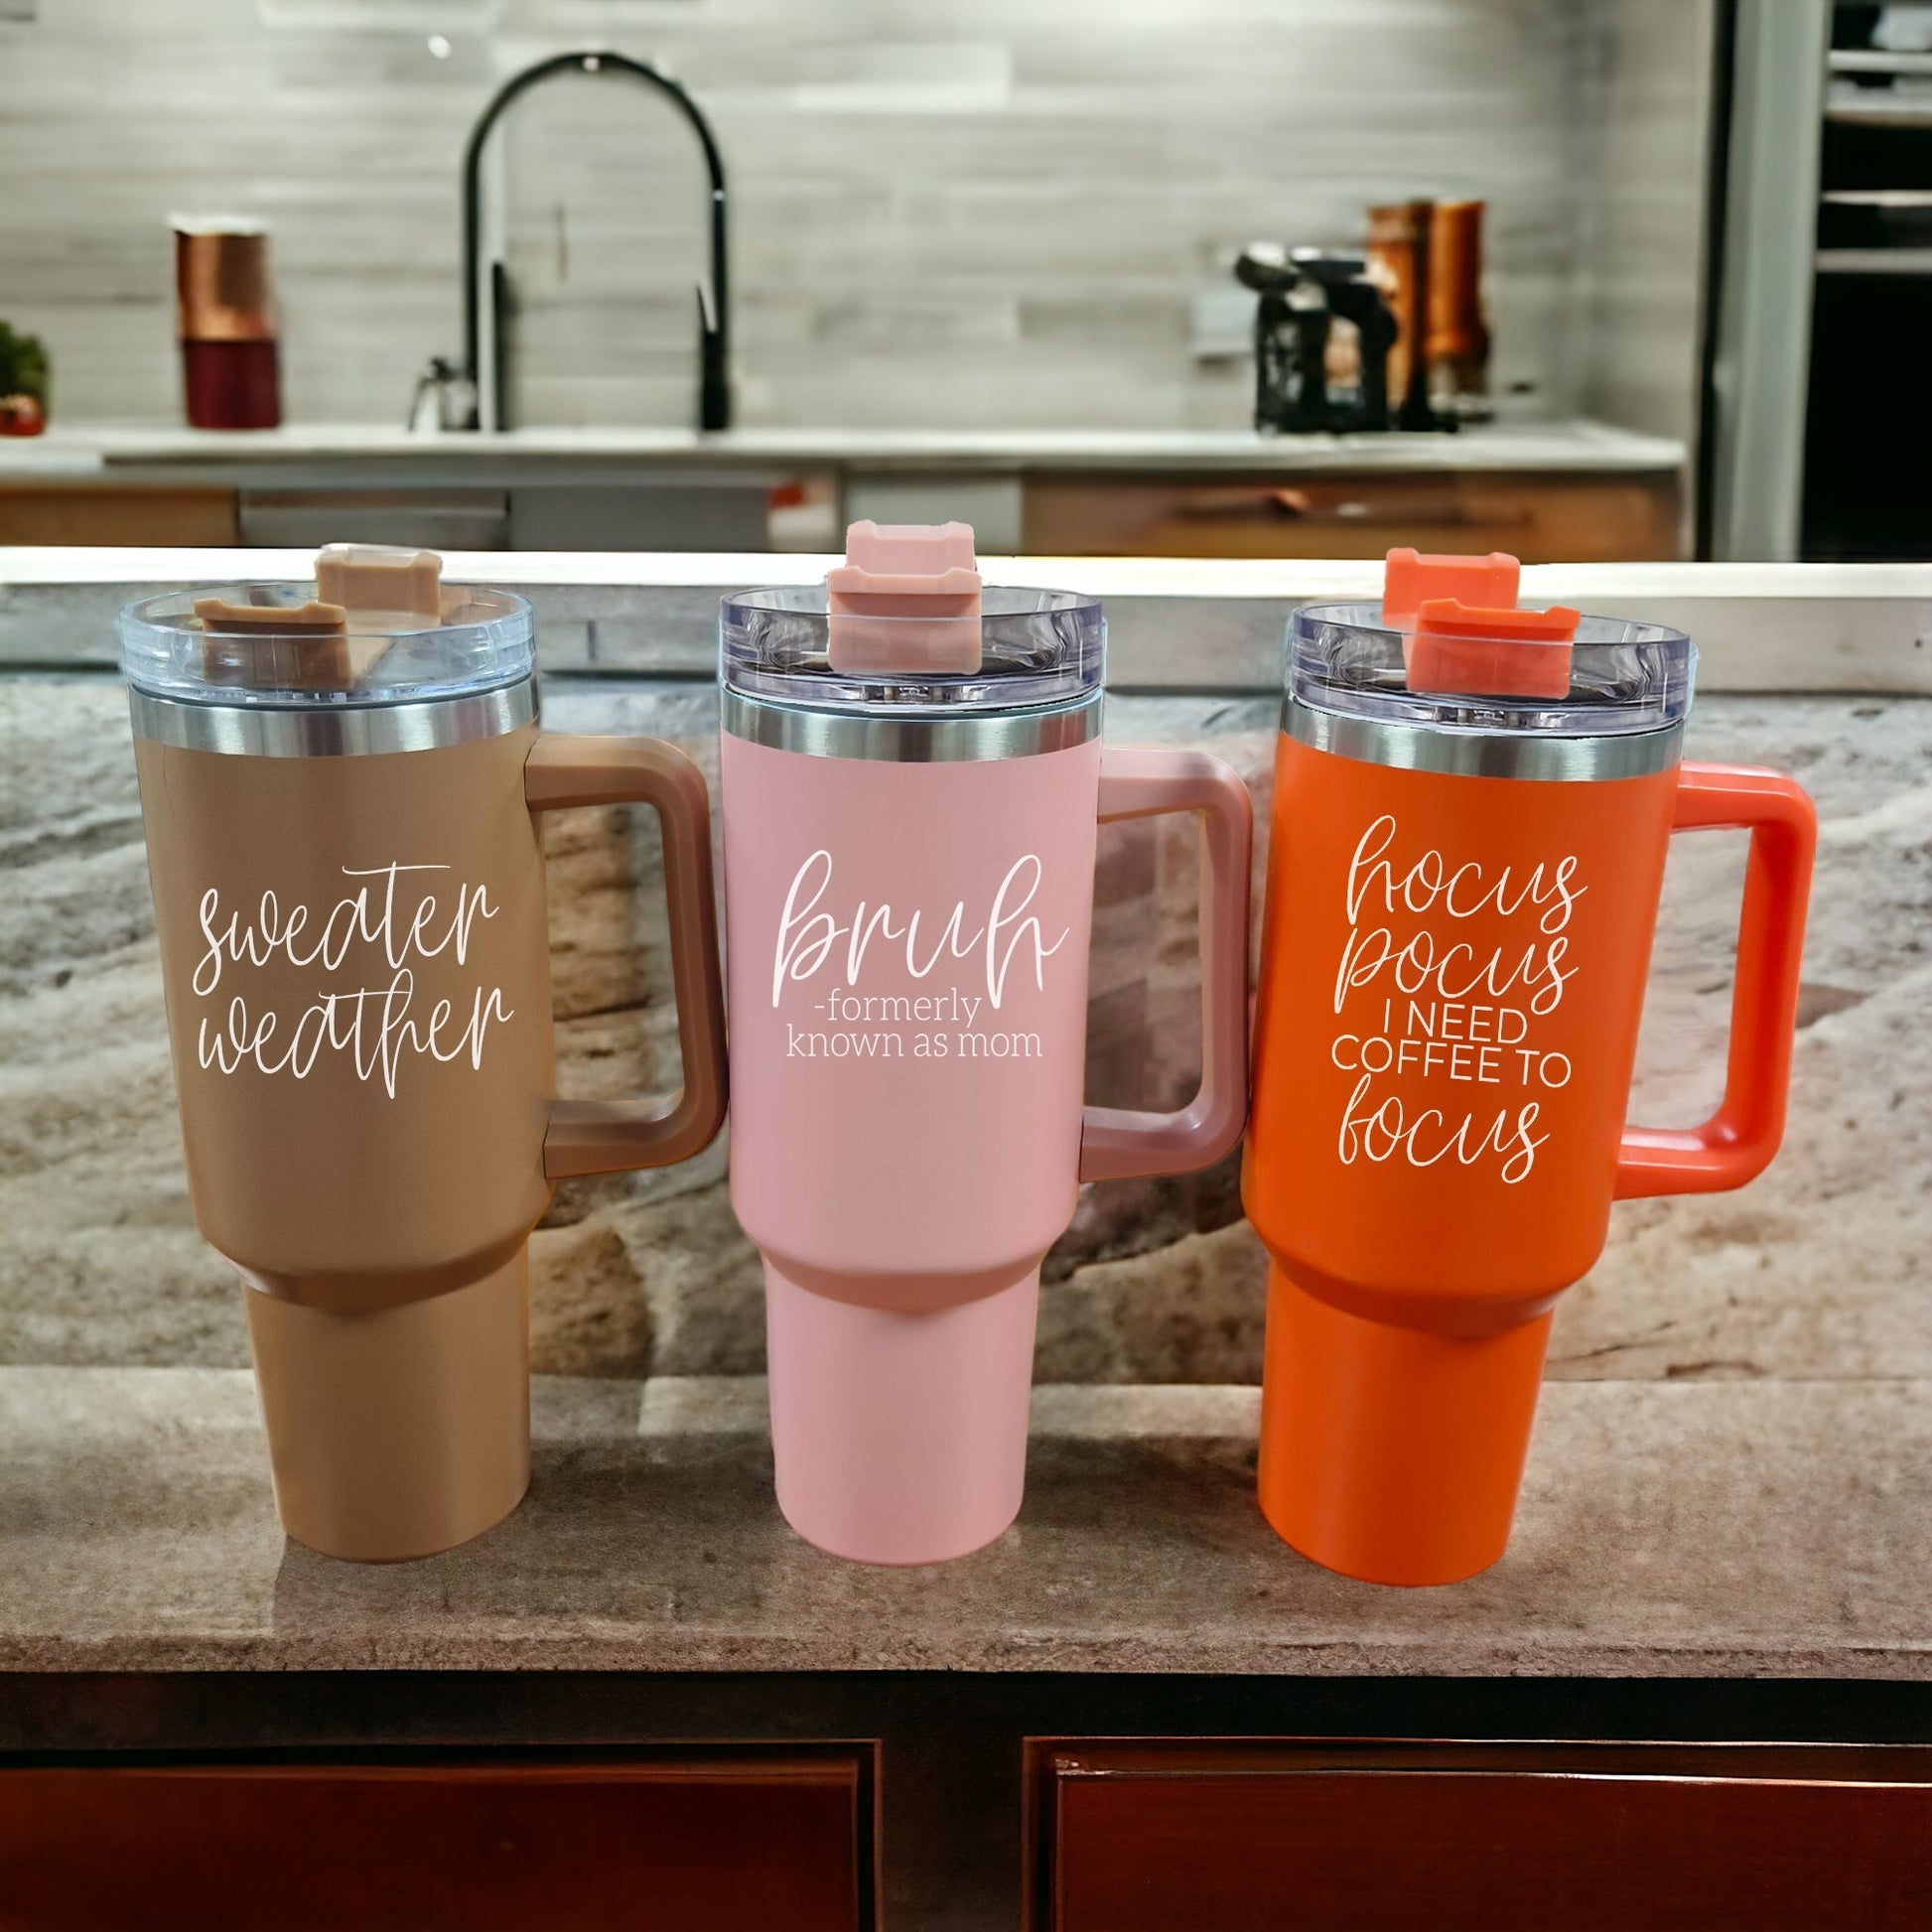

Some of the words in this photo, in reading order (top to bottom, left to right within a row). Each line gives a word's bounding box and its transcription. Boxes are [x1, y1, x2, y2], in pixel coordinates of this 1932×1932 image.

[1346, 814, 1588, 934] hocus
[193, 861, 499, 996] sweater
[772, 850, 1069, 1009] bruh
[1333, 927, 1580, 1016] pocus
[199, 968, 514, 1099] weather
[785, 1023, 904, 1058] known
[912, 1032, 949, 1058] as
[957, 1032, 1044, 1058] mom
[813, 987, 983, 1030] -formerly
[1383, 998, 1391, 1034] I
[1407, 1000, 1529, 1044] NEED
[1331, 1034, 1503, 1083] COFFEE
[1515, 1049, 1573, 1089] TO
[1338, 1072, 1550, 1184] focus
